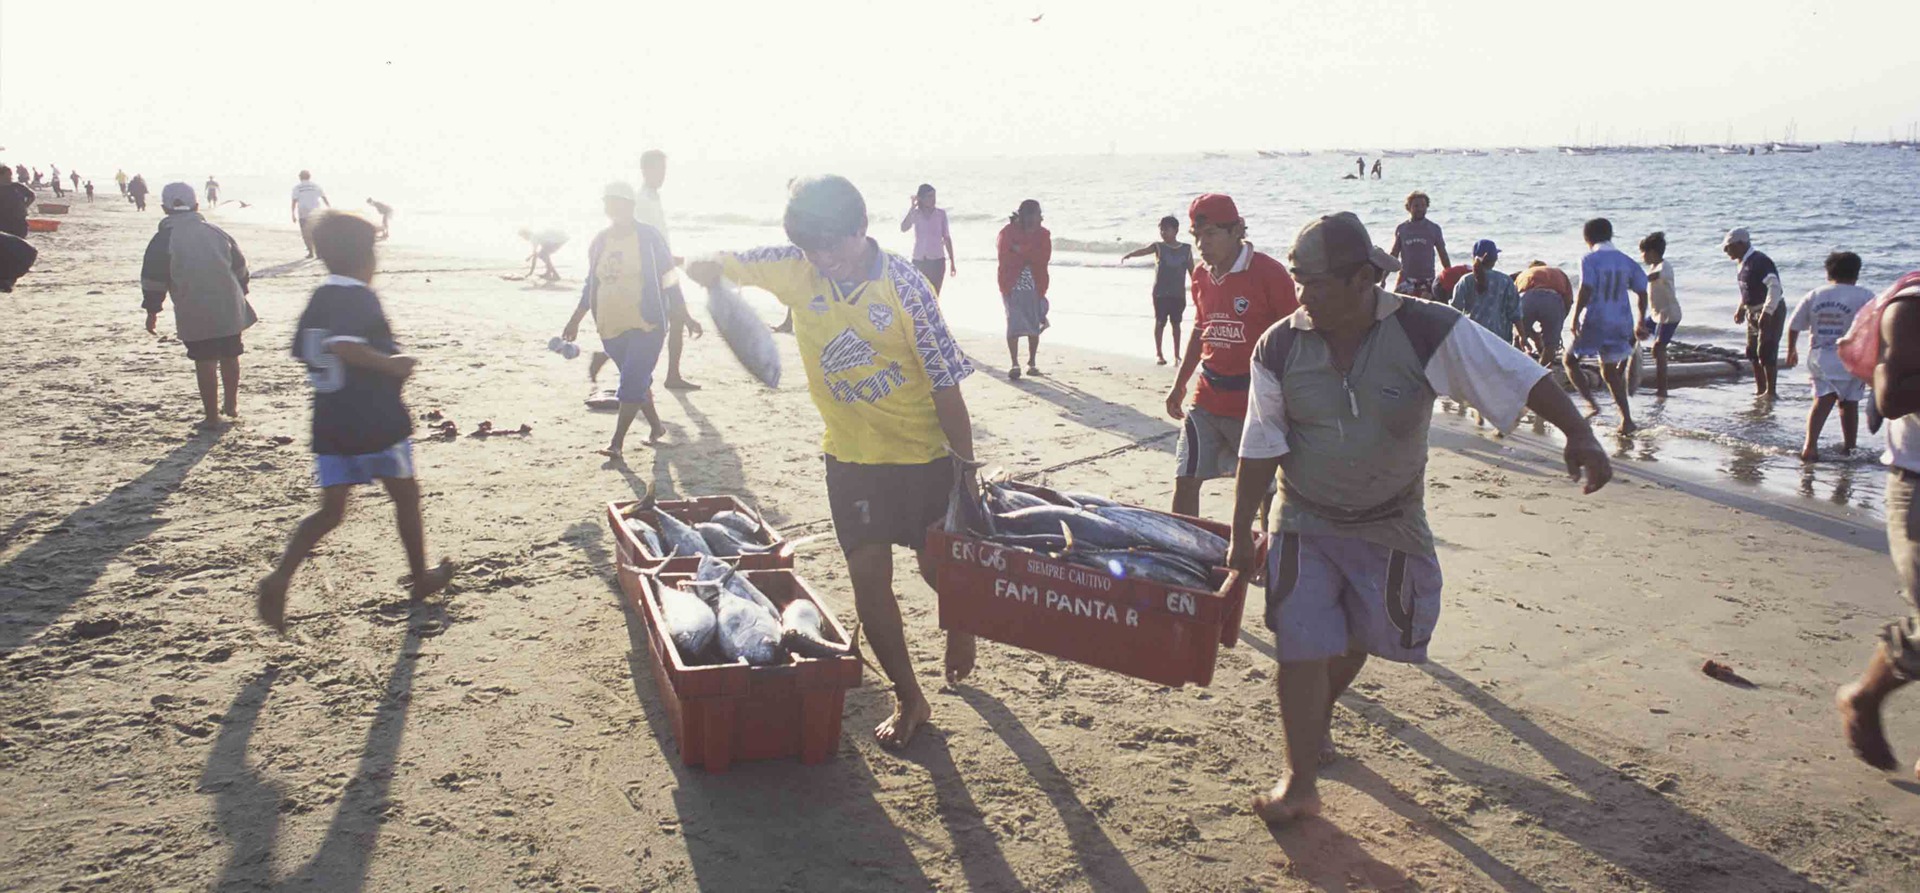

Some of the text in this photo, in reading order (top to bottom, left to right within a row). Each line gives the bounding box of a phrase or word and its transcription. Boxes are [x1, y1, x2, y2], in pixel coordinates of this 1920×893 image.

[1026, 559, 1113, 592] SIEMPRE CAUTIVO
[994, 578, 1039, 606] FAM
[1045, 589, 1119, 624] PANTA
